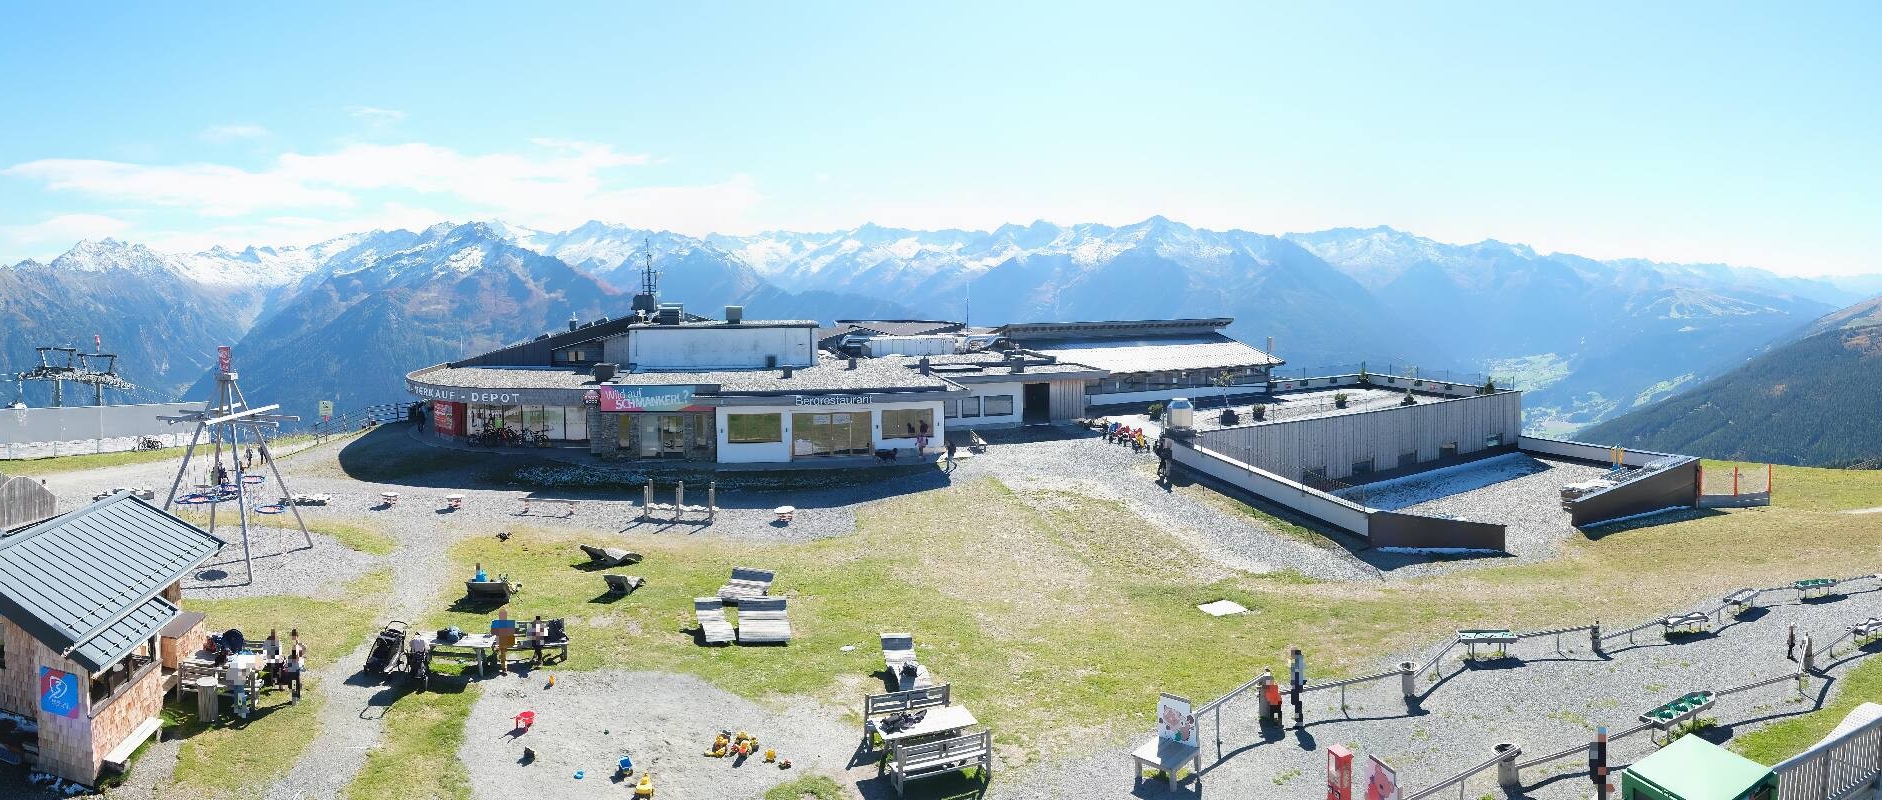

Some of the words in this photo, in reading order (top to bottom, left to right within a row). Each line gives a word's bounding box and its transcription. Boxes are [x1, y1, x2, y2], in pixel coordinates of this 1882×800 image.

[472, 392, 520, 402] DEPOT
[605, 389, 625, 400] Wild
[628, 388, 642, 398] auf
[616, 390, 688, 409] SCHMANKERL?
[795, 395, 873, 406] Bergrestaurant
